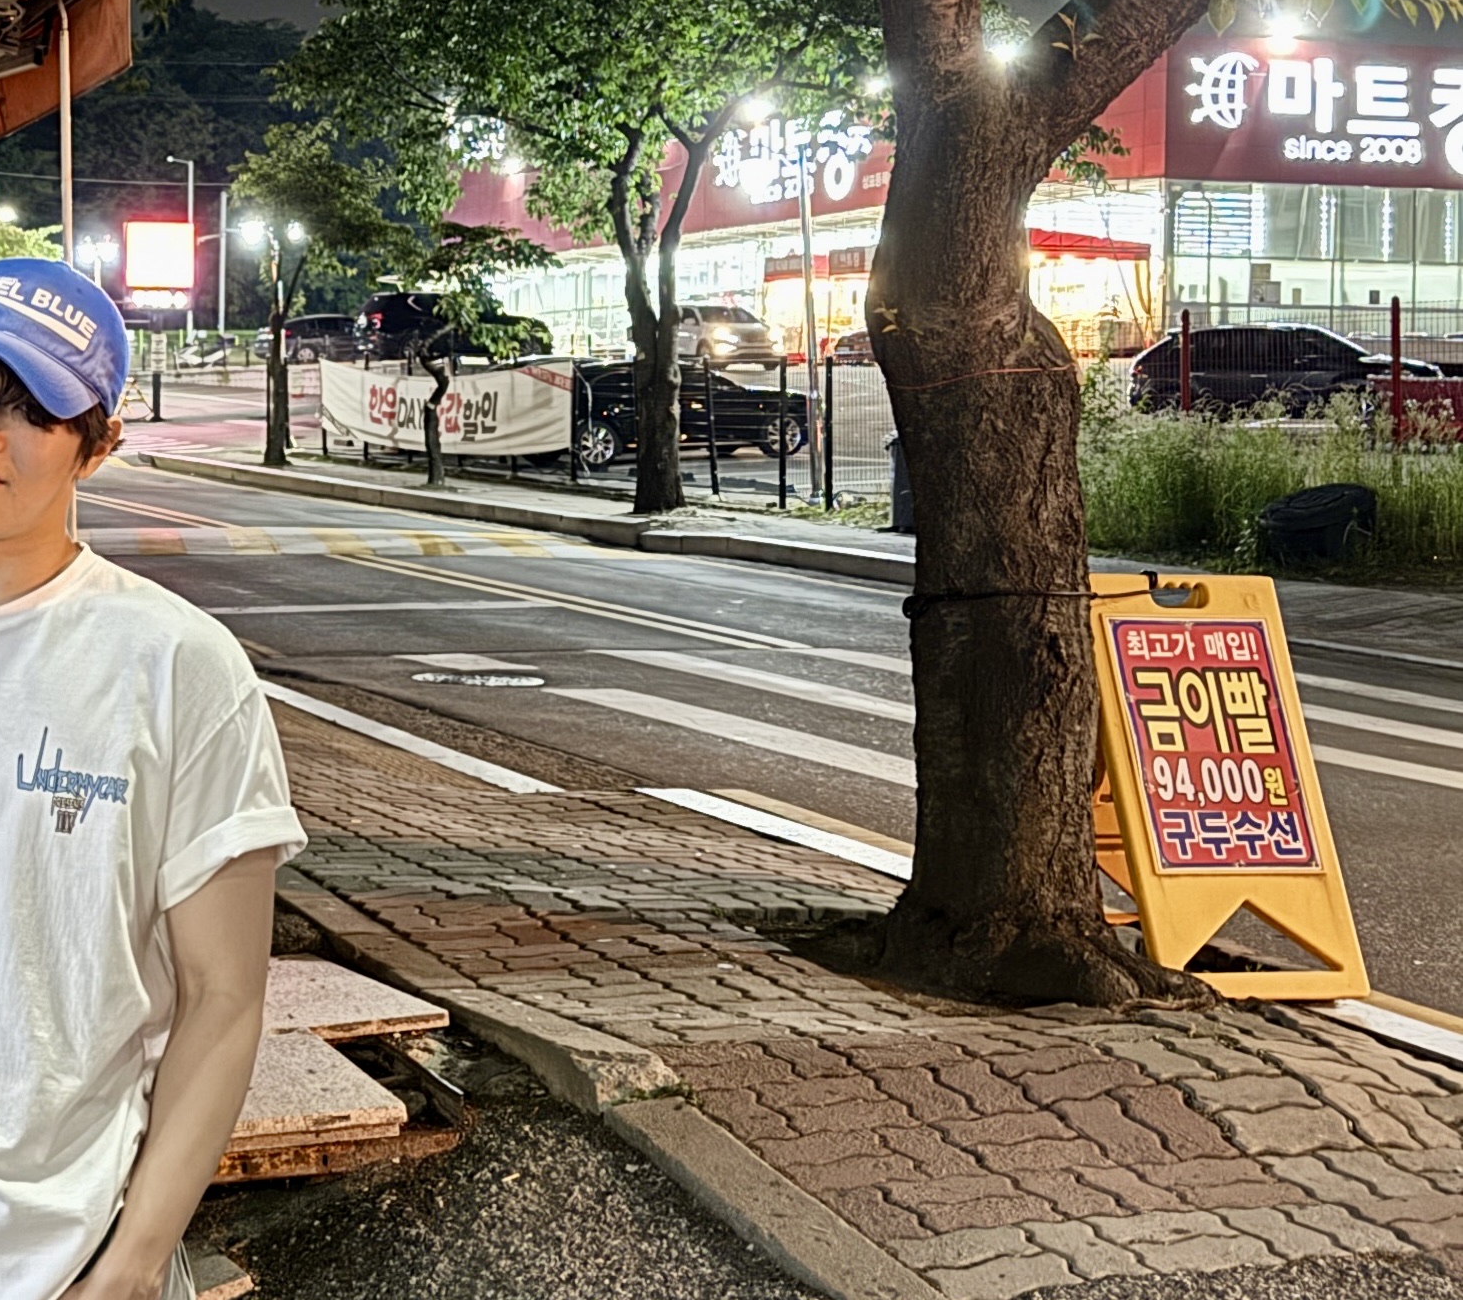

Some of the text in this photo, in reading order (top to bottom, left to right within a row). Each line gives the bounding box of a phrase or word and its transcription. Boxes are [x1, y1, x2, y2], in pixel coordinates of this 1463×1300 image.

[1283, 134, 1423, 165] since 2008
[31, 287, 97, 340] BLUE
[1127, 630, 1259, 661] 최고가 매입!
[1135, 669, 1276, 755] 금이빨
[1160, 810, 1305, 859] 구두수선
